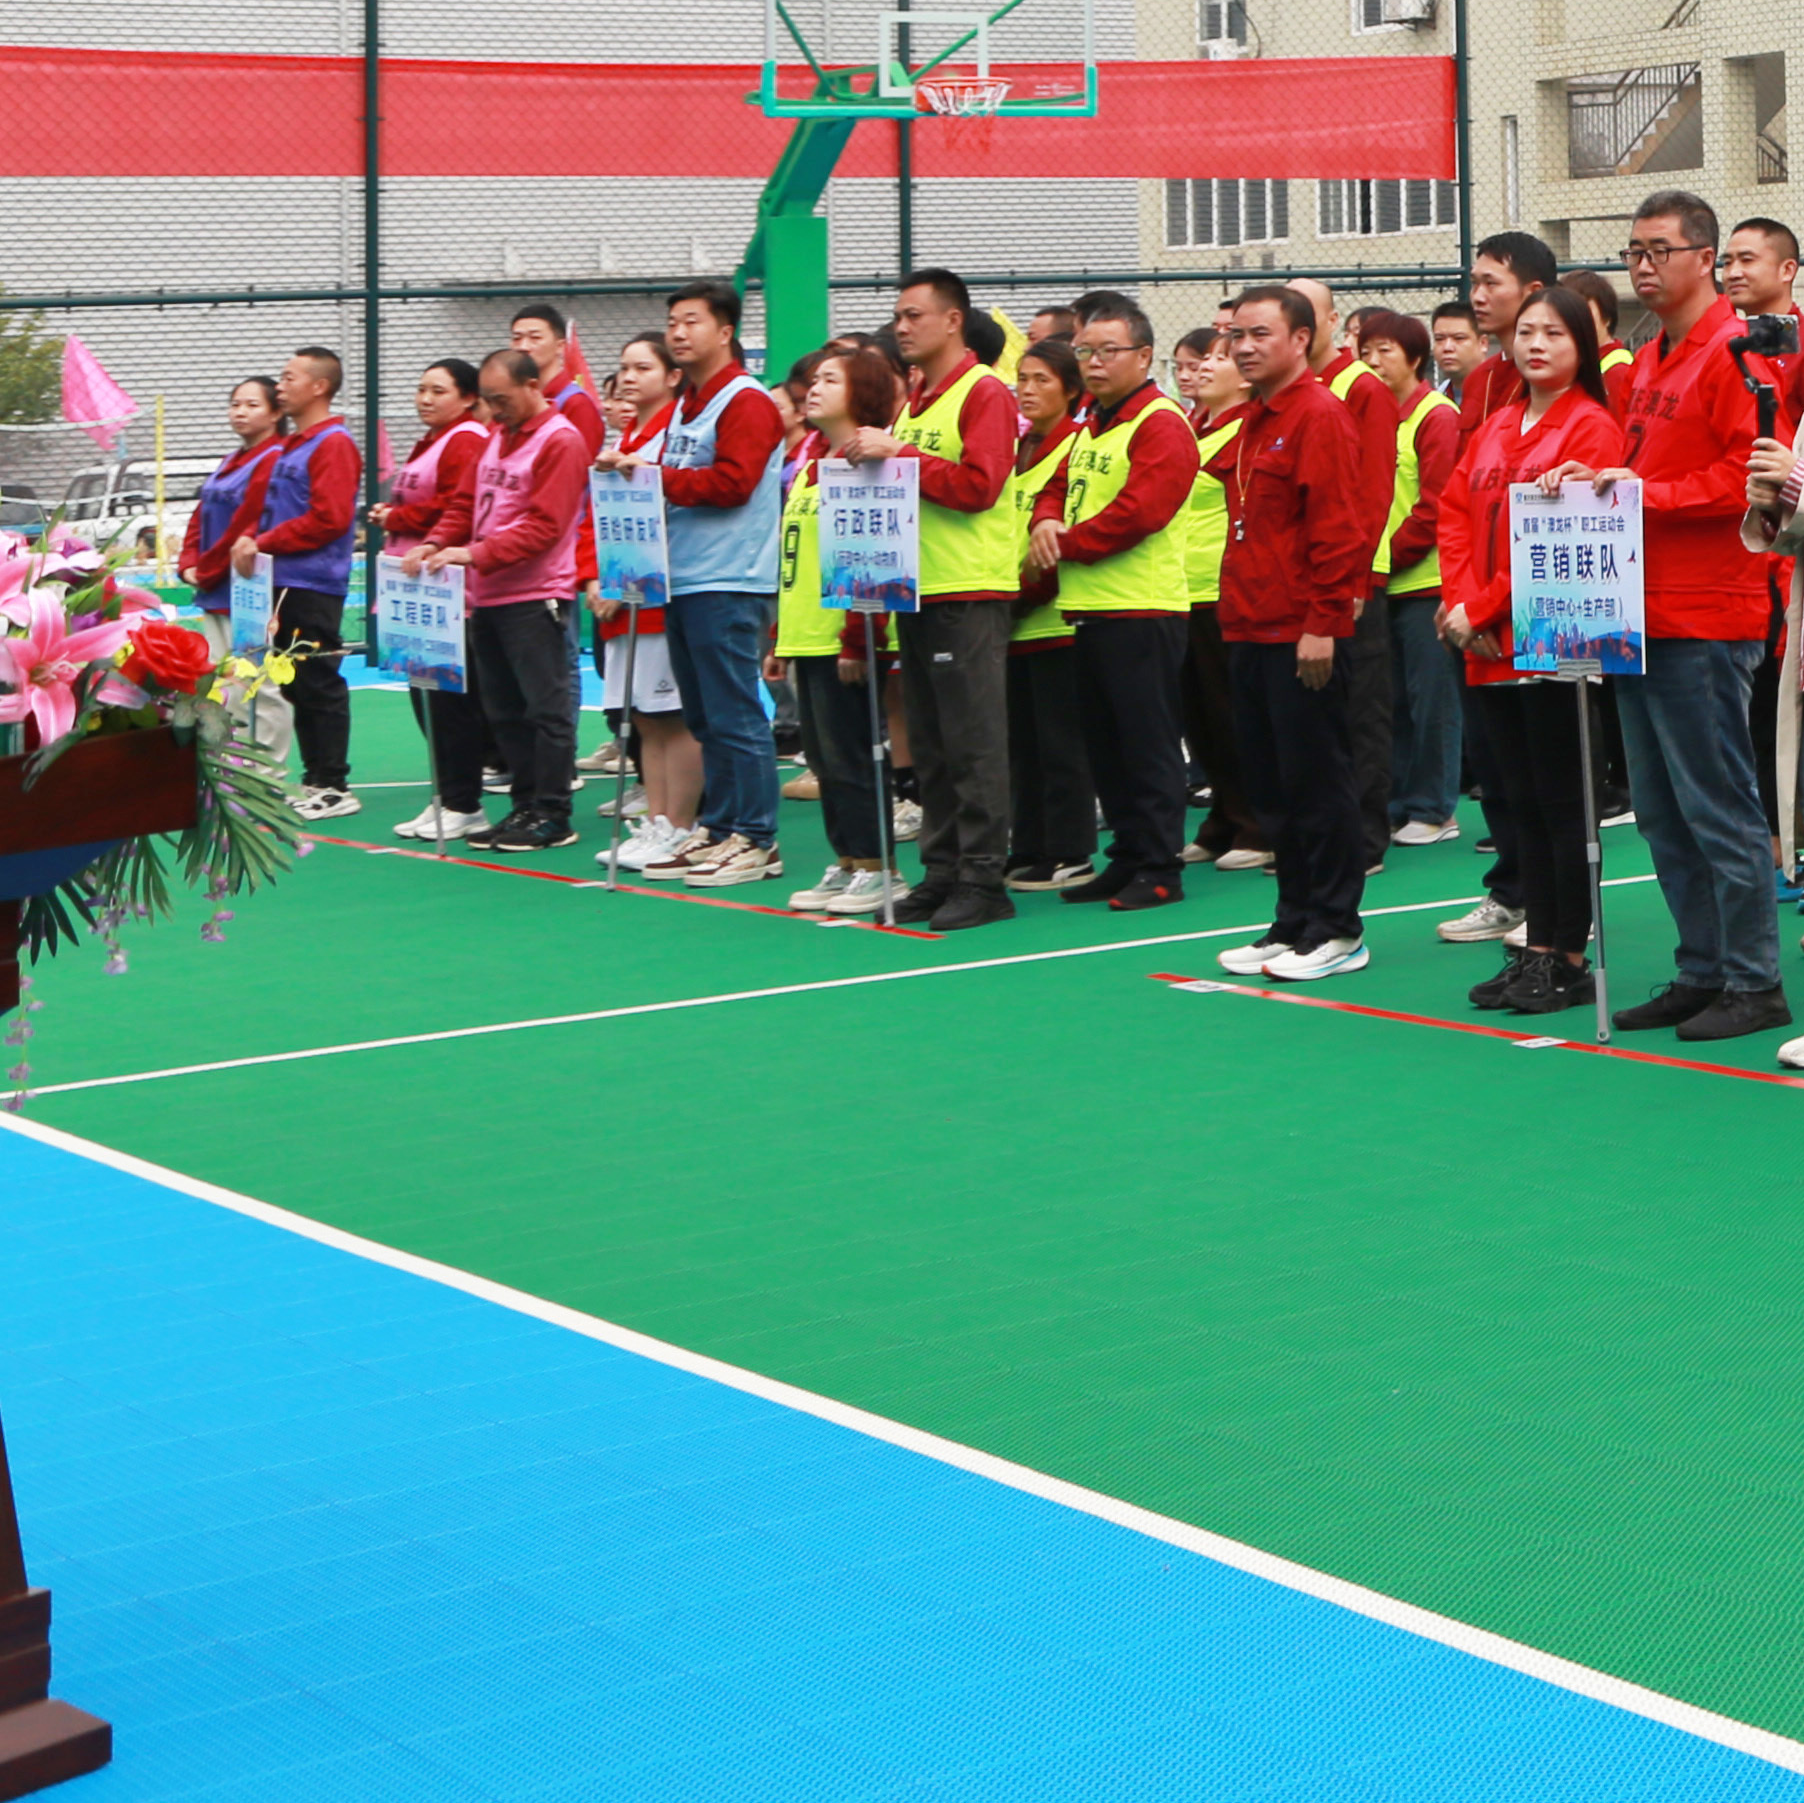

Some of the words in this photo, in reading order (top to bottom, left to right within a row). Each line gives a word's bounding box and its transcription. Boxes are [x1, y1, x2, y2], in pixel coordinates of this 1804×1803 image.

[834, 508, 901, 536] 行政联队
[1530, 543, 1618, 580] 营销联队
[391, 599, 448, 629] 工程联队
